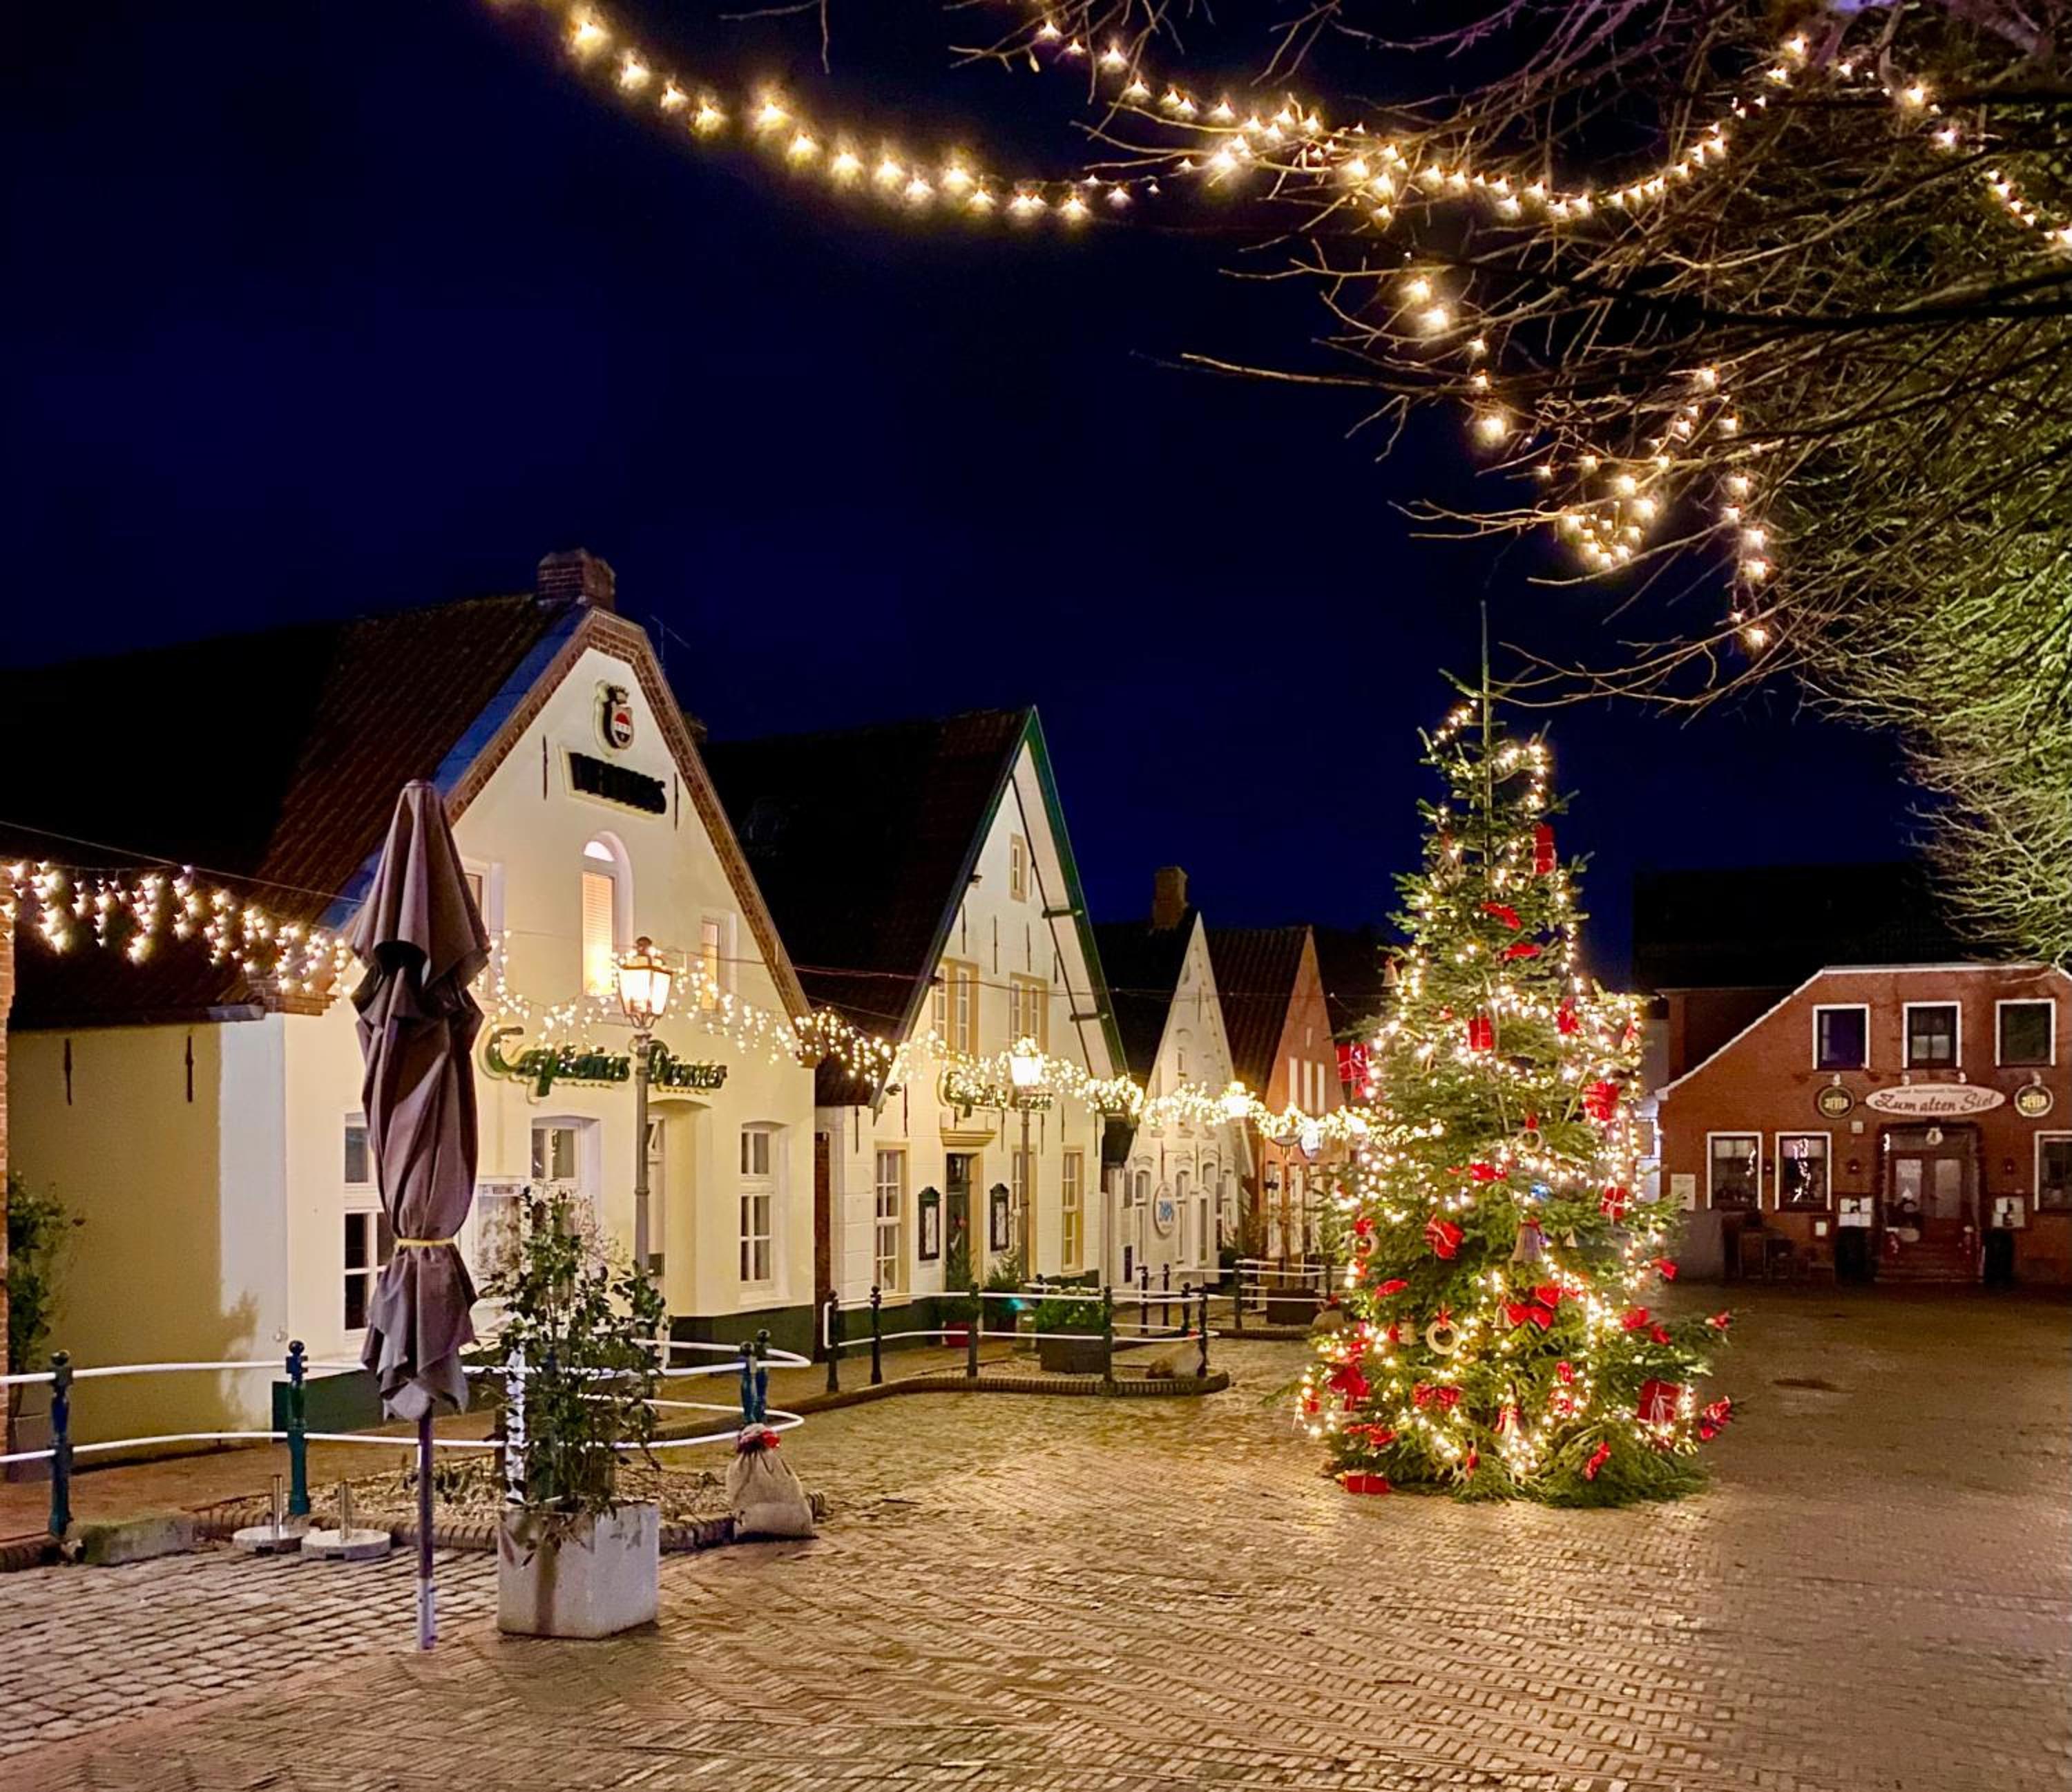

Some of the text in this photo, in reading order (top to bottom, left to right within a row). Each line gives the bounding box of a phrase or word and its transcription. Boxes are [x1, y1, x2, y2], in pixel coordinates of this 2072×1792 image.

[1874, 1092, 1996, 1112] Zum alten Siel
